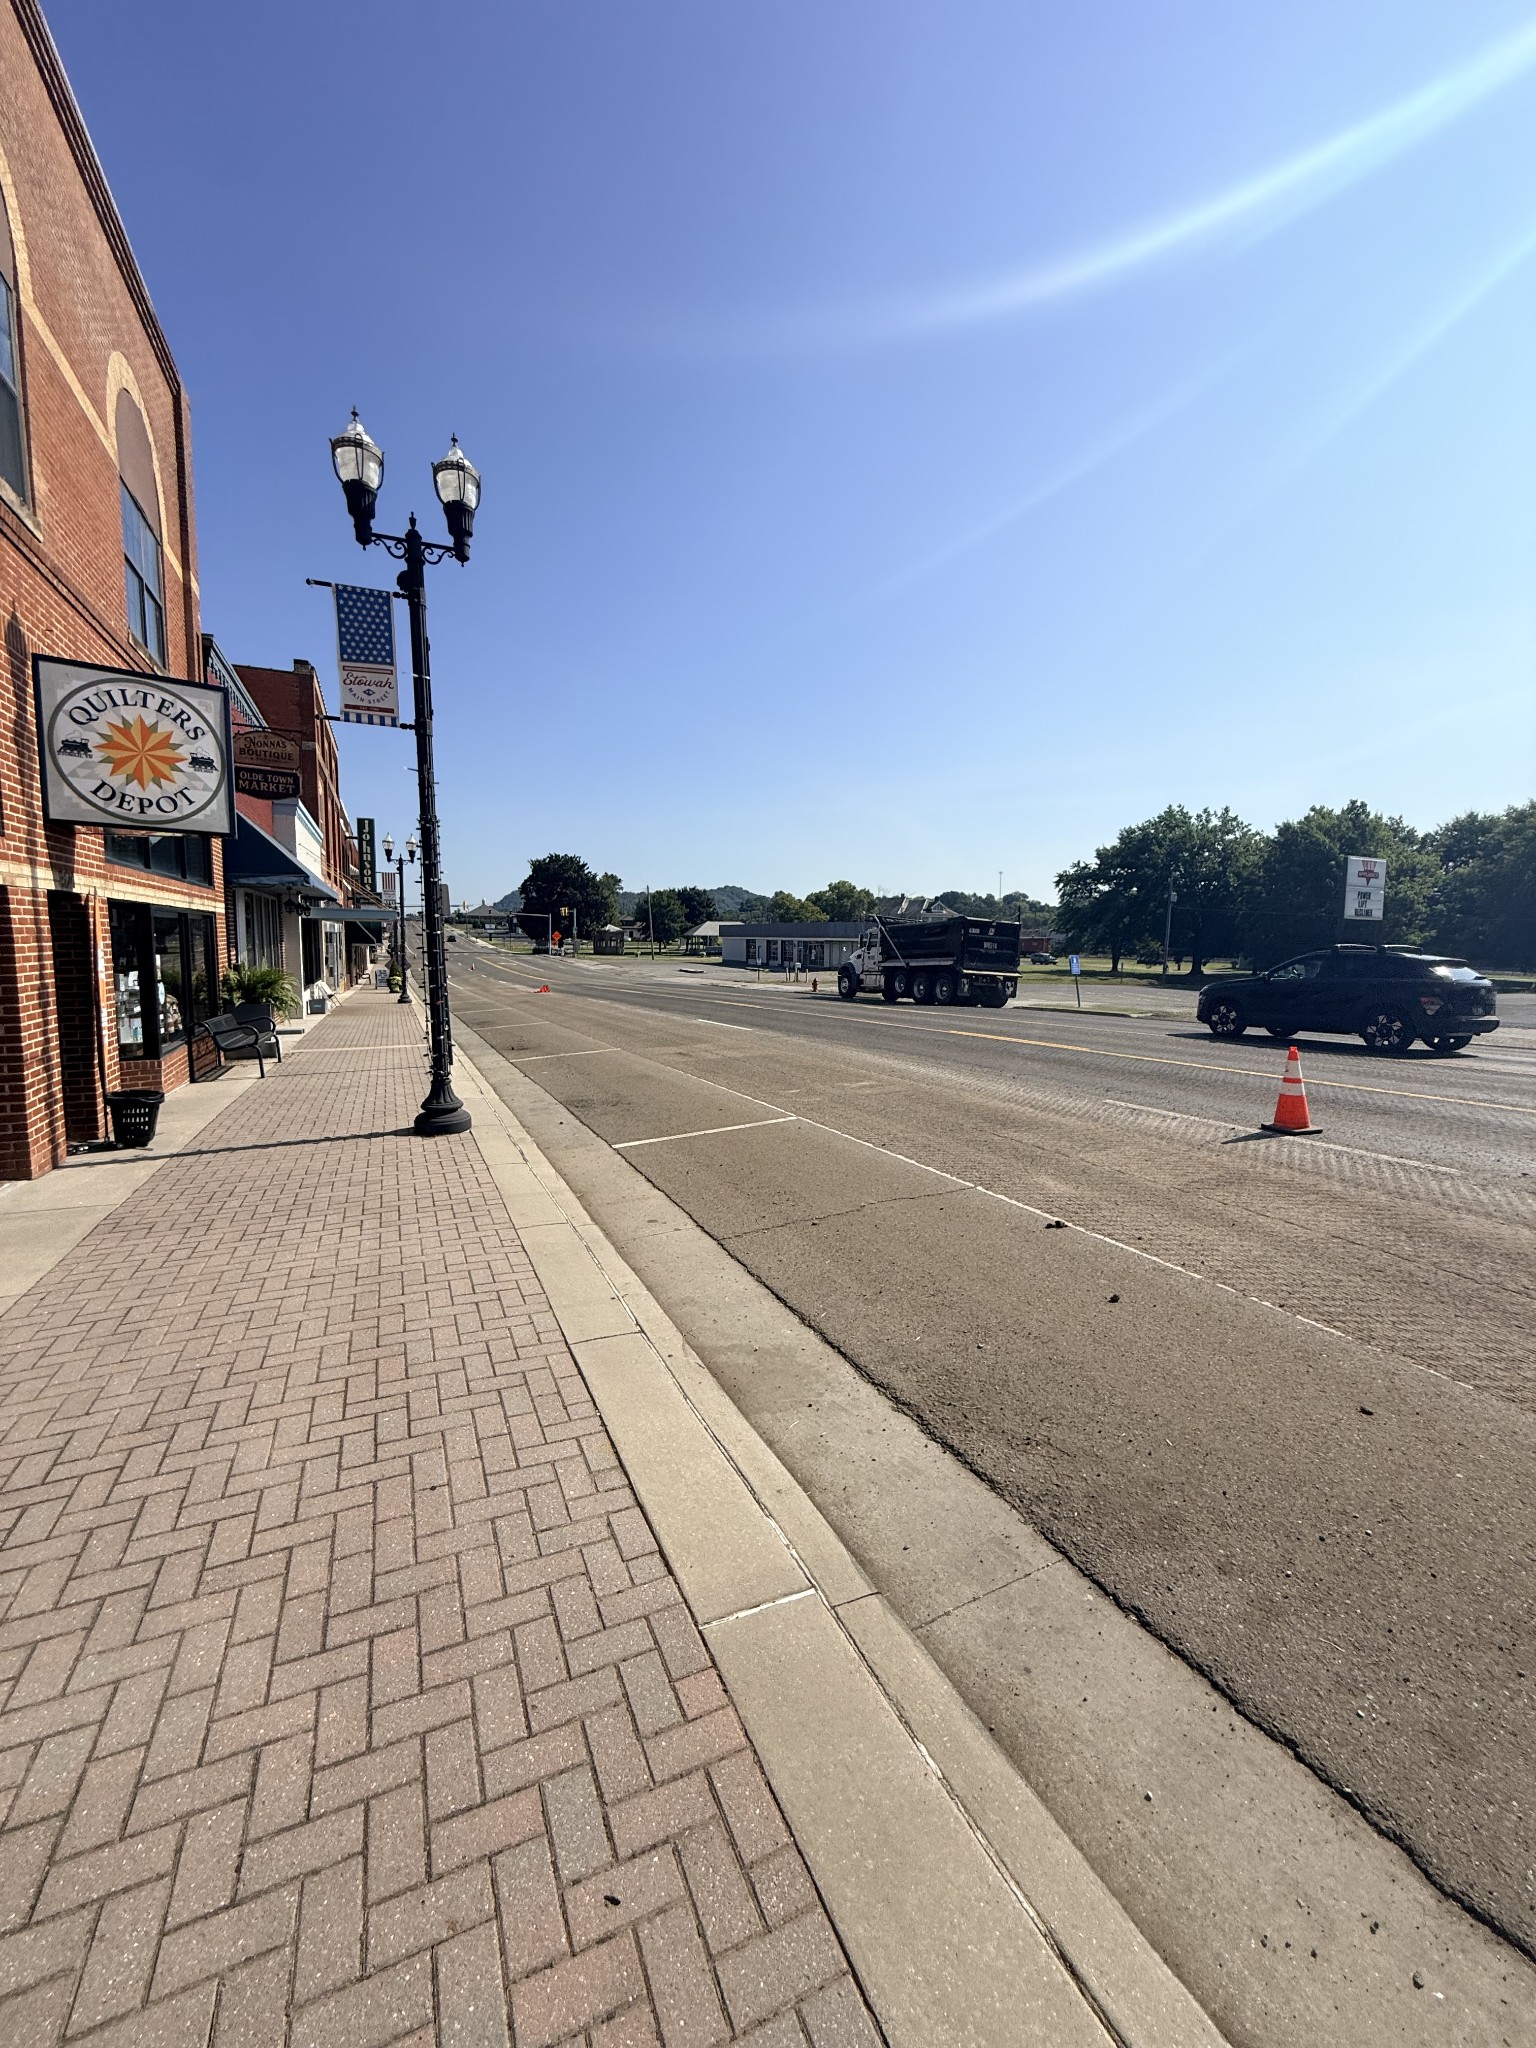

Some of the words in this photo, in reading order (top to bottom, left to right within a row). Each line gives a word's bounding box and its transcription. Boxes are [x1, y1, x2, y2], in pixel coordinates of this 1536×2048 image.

[343, 672, 394, 689] Etowah
[348, 687, 365, 702] MAIN
[368, 690, 391, 704] STREET
[69, 688, 206, 741] QUILTERS
[239, 747, 294, 760] BOUTIQUE
[240, 771, 264, 781] OLDE
[267, 774, 294, 785] TOWN
[238, 780, 296, 794] MARKET
[90, 779, 196, 815] DEPOT
[362, 820, 372, 891] Johnsons
[1357, 891, 1371, 900] POWER
[1358, 900, 1367, 908] LIFT
[1354, 908, 1373, 917] RECLINER
